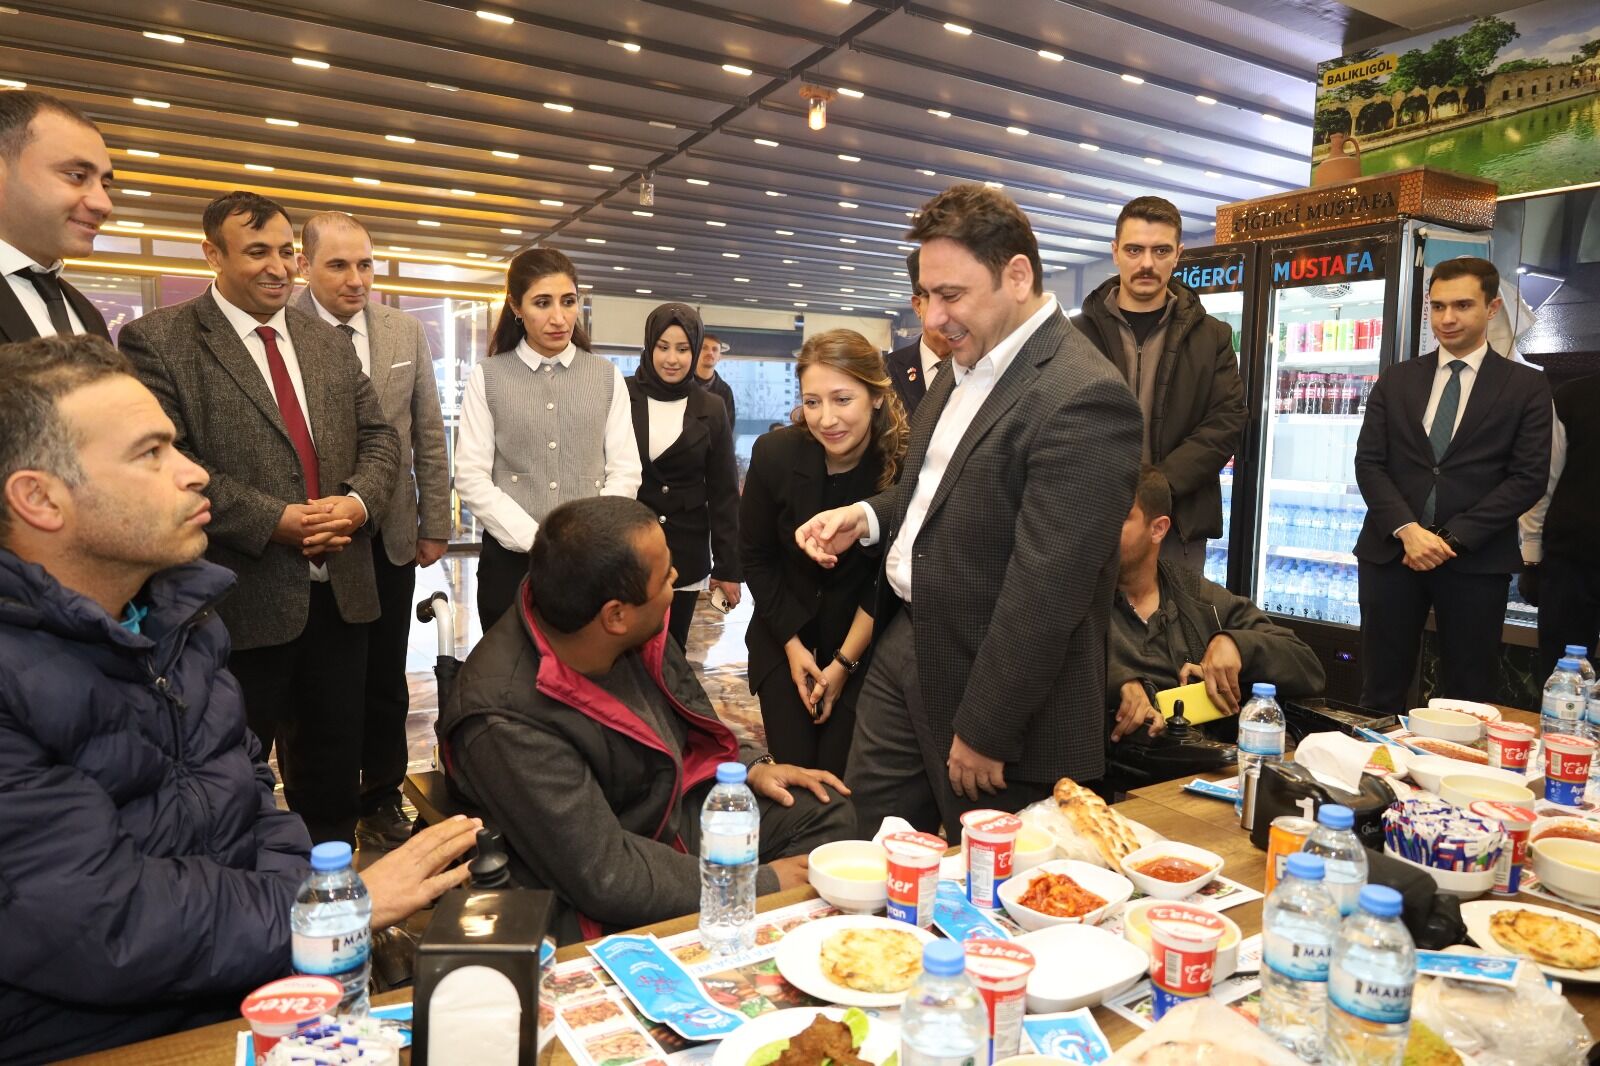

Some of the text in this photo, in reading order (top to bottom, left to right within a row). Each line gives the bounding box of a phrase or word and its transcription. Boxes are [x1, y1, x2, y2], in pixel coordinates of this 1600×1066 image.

[1327, 60, 1393, 85] BALIKLIGÖL
[1306, 191, 1395, 221] MUSTAFA
[1274, 251, 1374, 282] MUSTAFA
